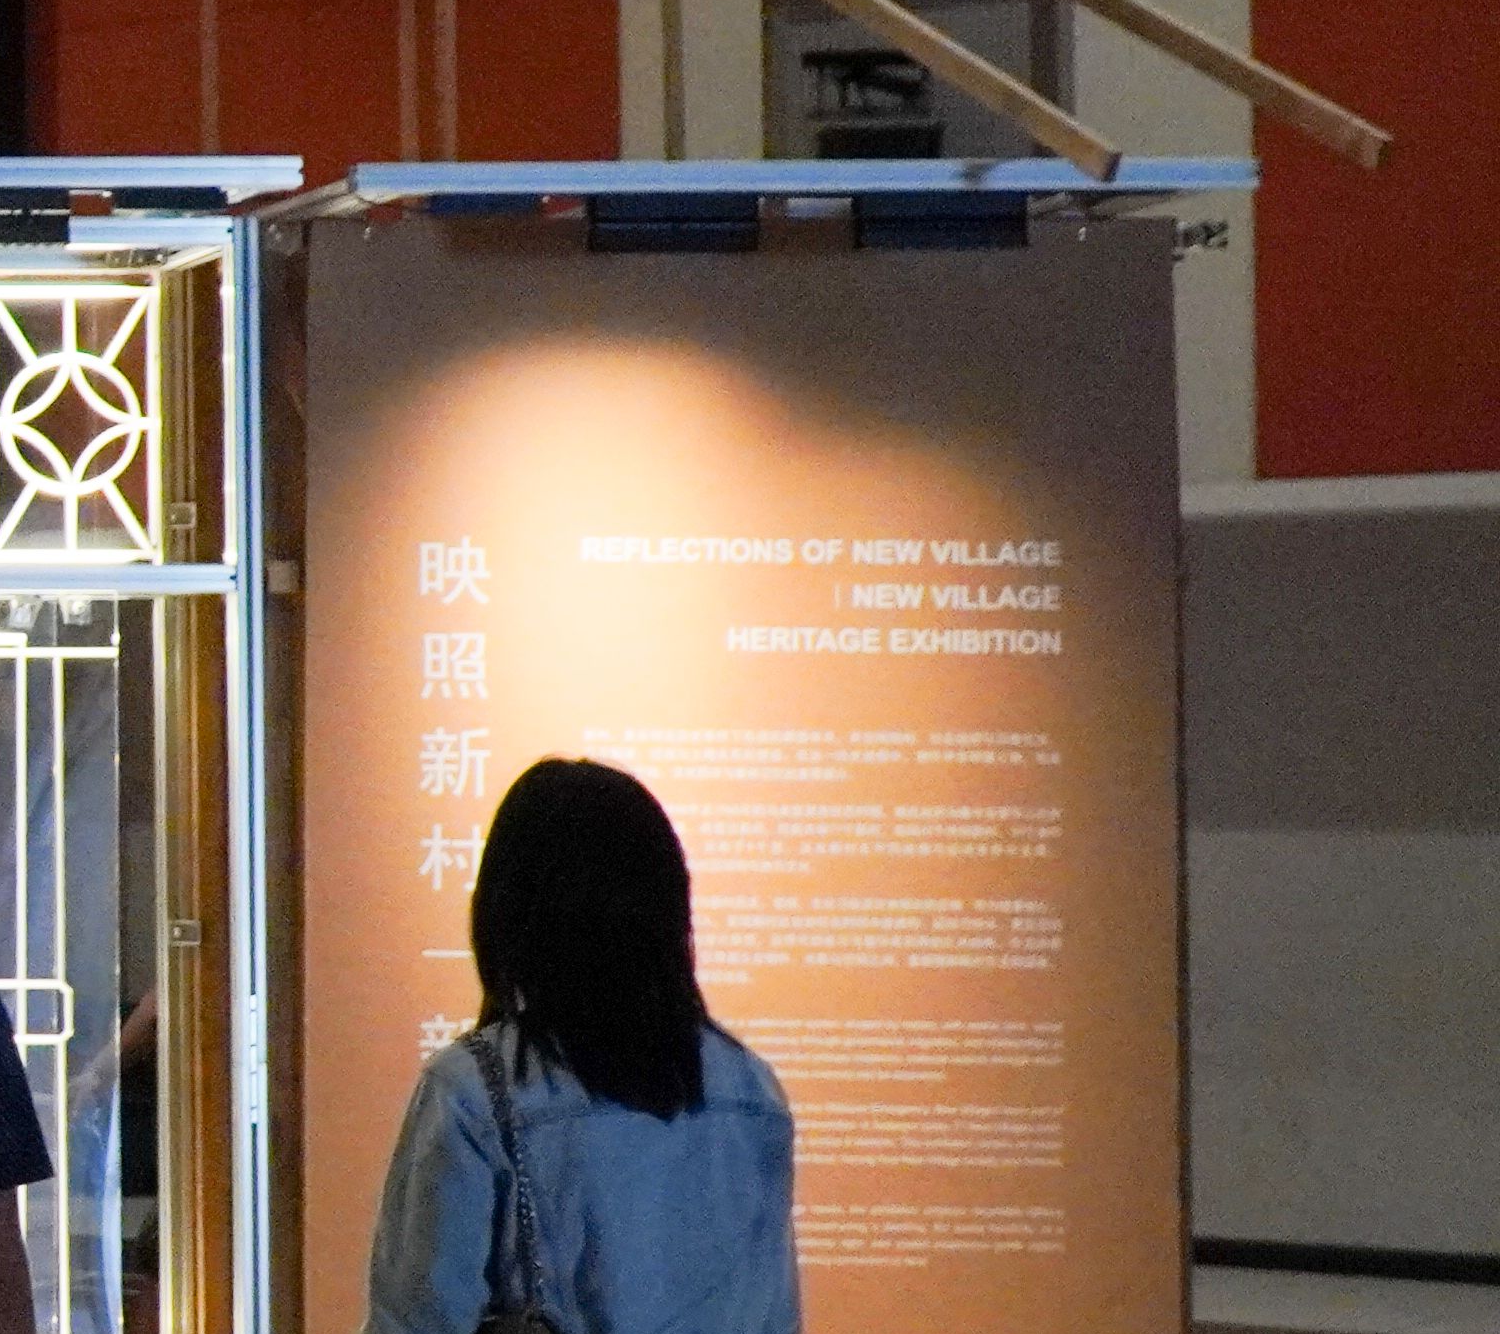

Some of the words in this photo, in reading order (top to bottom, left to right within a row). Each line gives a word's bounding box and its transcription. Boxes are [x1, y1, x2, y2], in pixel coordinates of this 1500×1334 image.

[580, 537, 793, 565] REFLECTIONS
[800, 538, 843, 565] OF
[852, 539, 924, 566] NEW
[930, 539, 1063, 567] VILLAGE
[852, 583, 924, 610] NEW
[930, 584, 1062, 611] VILLAGE
[726, 626, 881, 654] HERITAGE
[888, 627, 1063, 656] EXHIBITION
